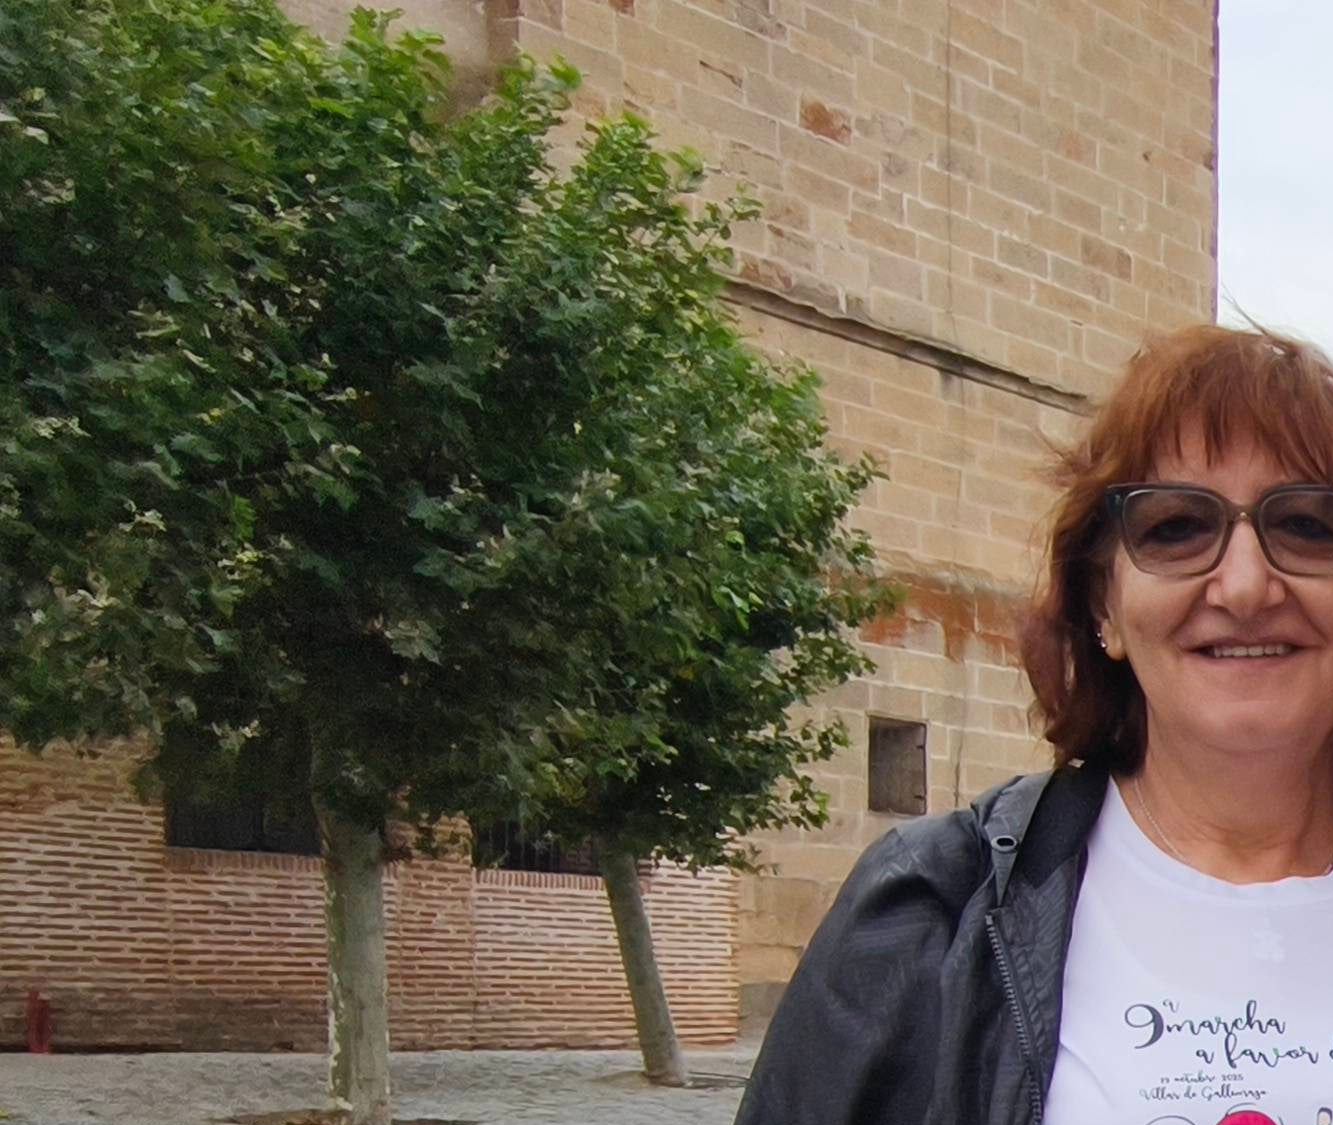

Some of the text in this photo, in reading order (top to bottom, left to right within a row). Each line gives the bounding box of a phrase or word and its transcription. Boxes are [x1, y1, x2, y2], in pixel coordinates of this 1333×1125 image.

[1166, 1000, 1286, 1034] marcha
[1196, 1049, 1214, 1064] a
[1225, 1033, 1319, 1069] favor
